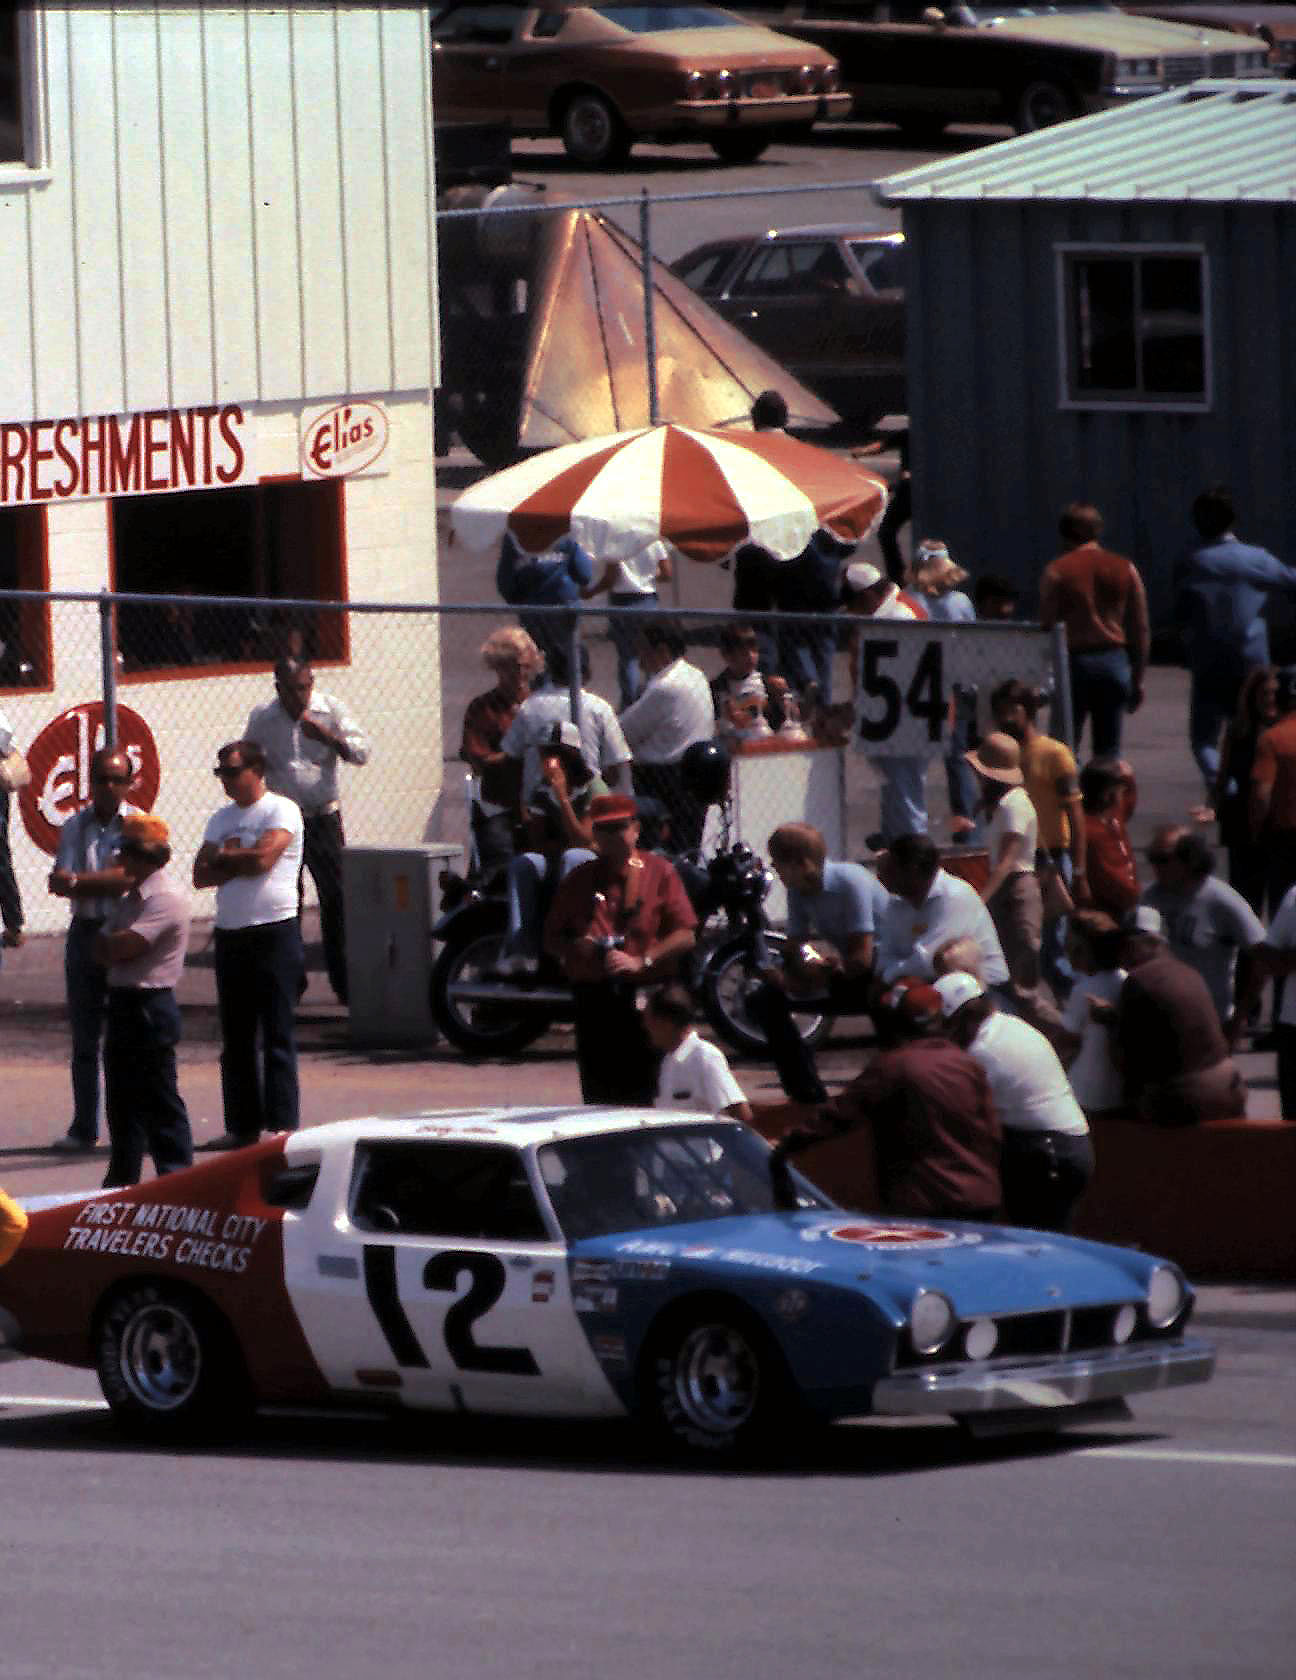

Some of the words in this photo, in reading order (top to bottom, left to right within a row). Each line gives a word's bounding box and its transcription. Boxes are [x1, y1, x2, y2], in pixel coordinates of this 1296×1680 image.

[860, 640, 948, 742] 54
[64, 1227, 174, 1259] TRAVELERS
[175, 1238, 251, 1273] CHECKS
[76, 1203, 135, 1225] FIRST
[132, 1204, 217, 1237] NATIONAL
[222, 1215, 268, 1243] CITY
[363, 1245, 542, 1376] 12
